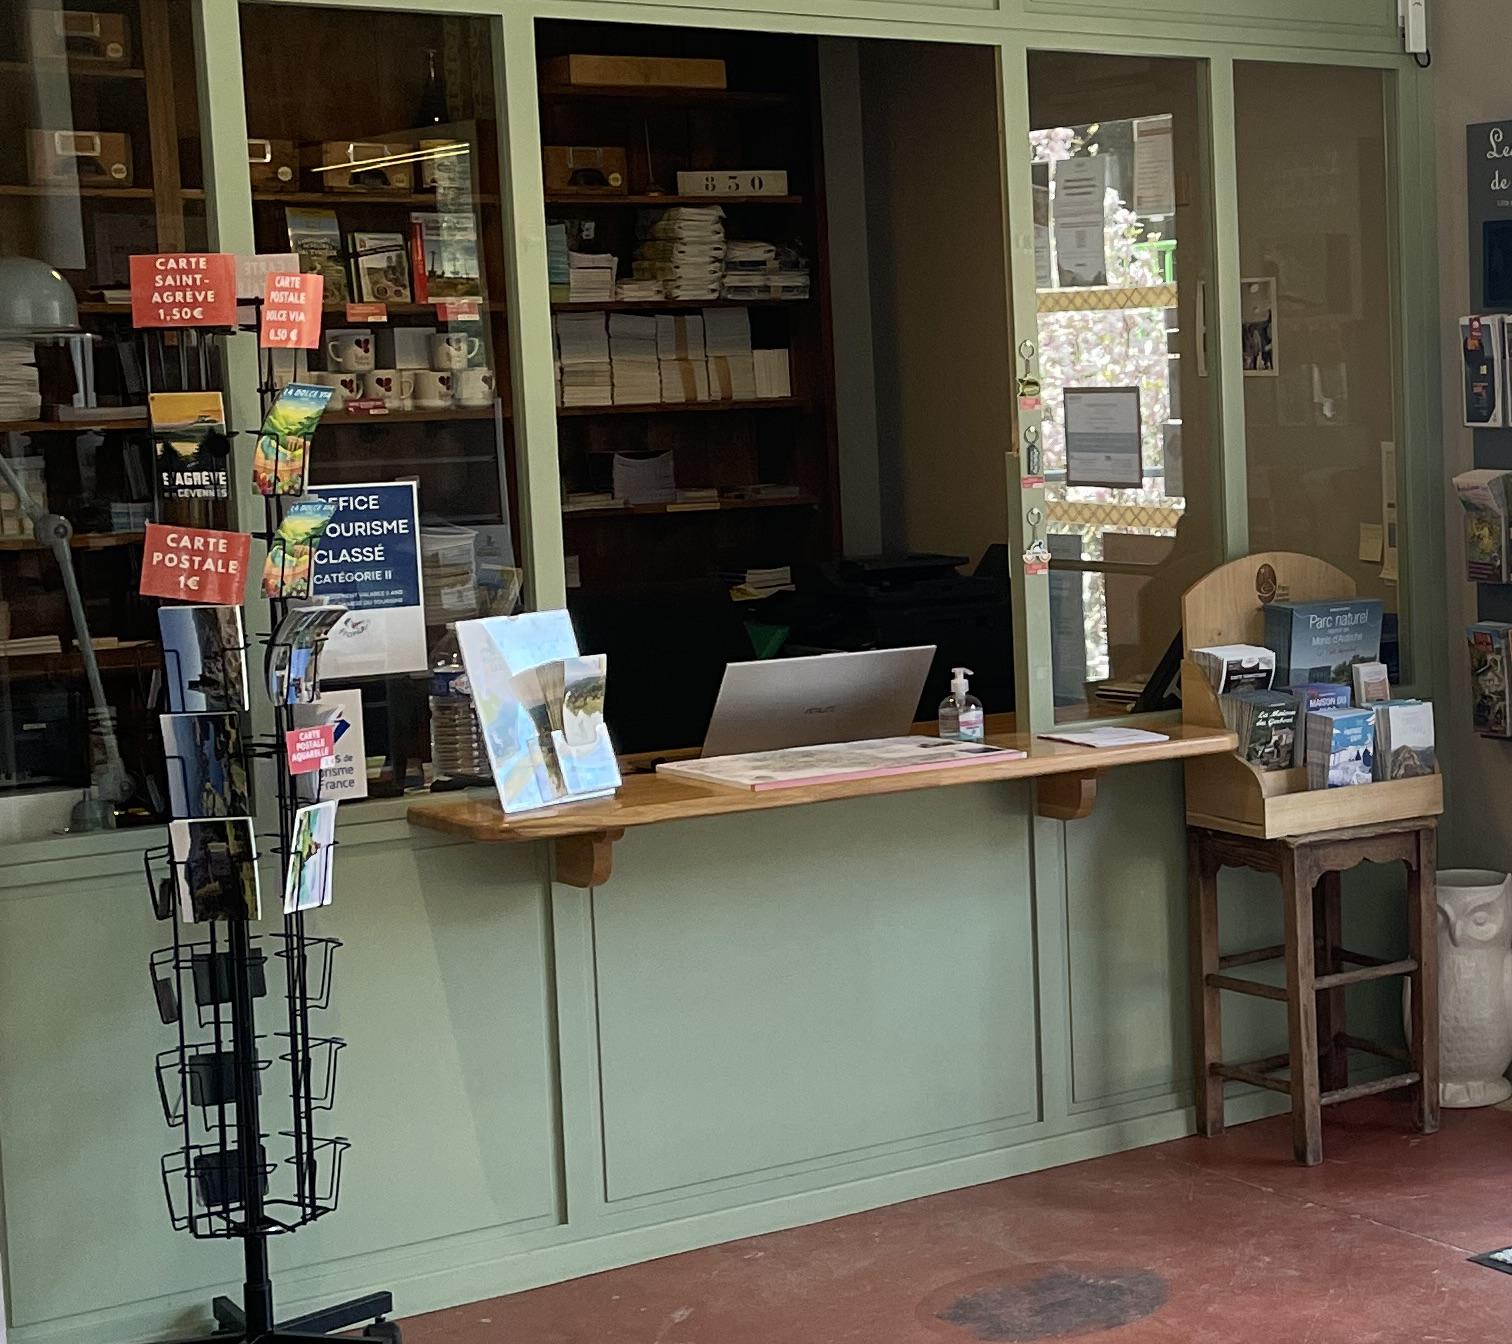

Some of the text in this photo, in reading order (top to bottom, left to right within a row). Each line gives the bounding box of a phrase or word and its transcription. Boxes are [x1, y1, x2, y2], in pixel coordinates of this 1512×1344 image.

[1490, 170, 1511, 190] de
[155, 258, 207, 270] CARTE
[154, 274, 209, 286] SAINT-
[275, 276, 300, 288] CARTE
[152, 288, 215, 304] AGRÈVE
[270, 291, 306, 304] POSTALE
[159, 308, 203, 320] 1,50€
[290, 310, 305, 322] VIA
[326, 520, 409, 537] OURISME
[166, 533, 228, 553] CARTE
[314, 543, 385, 564] CLASSÉ
[152, 553, 239, 573] POSTALE
[179, 575, 200, 590] 1€
[314, 570, 382, 584] CATÉGORIE
[1310, 609, 1368, 629] Parc naturel
[1310, 699, 1335, 707] MAISON
[299, 730, 320, 741] CARTE
[296, 738, 325, 751] POSTALE
[292, 747, 329, 763] AQUARELLE
